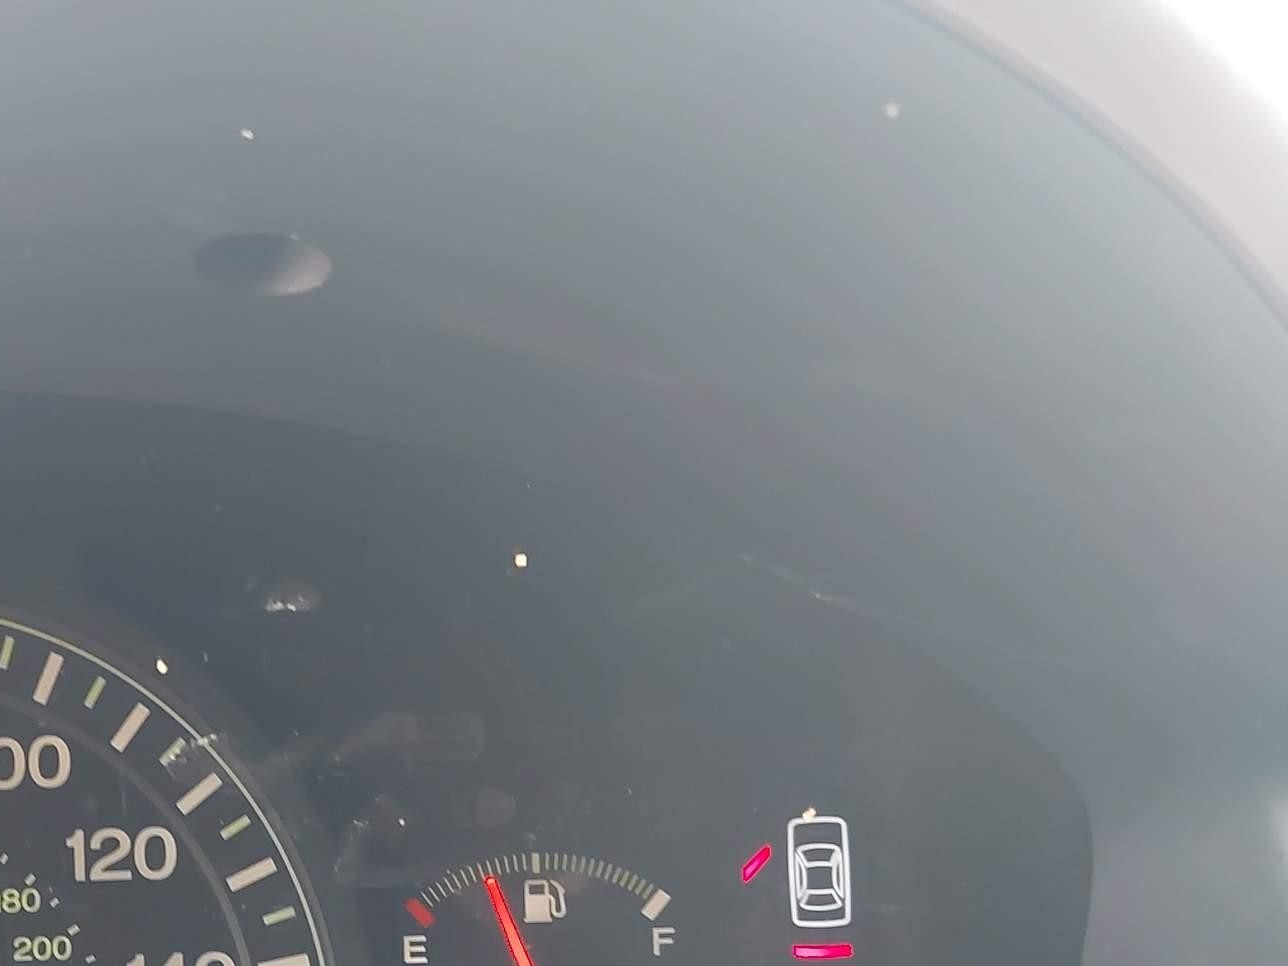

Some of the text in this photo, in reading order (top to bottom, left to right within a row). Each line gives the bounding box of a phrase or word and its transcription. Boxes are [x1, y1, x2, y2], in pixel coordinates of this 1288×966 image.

[65, 827, 177, 881] 120
[13, 936, 72, 962] 200
[403, 936, 428, 964] E
[652, 927, 675, 956] F
